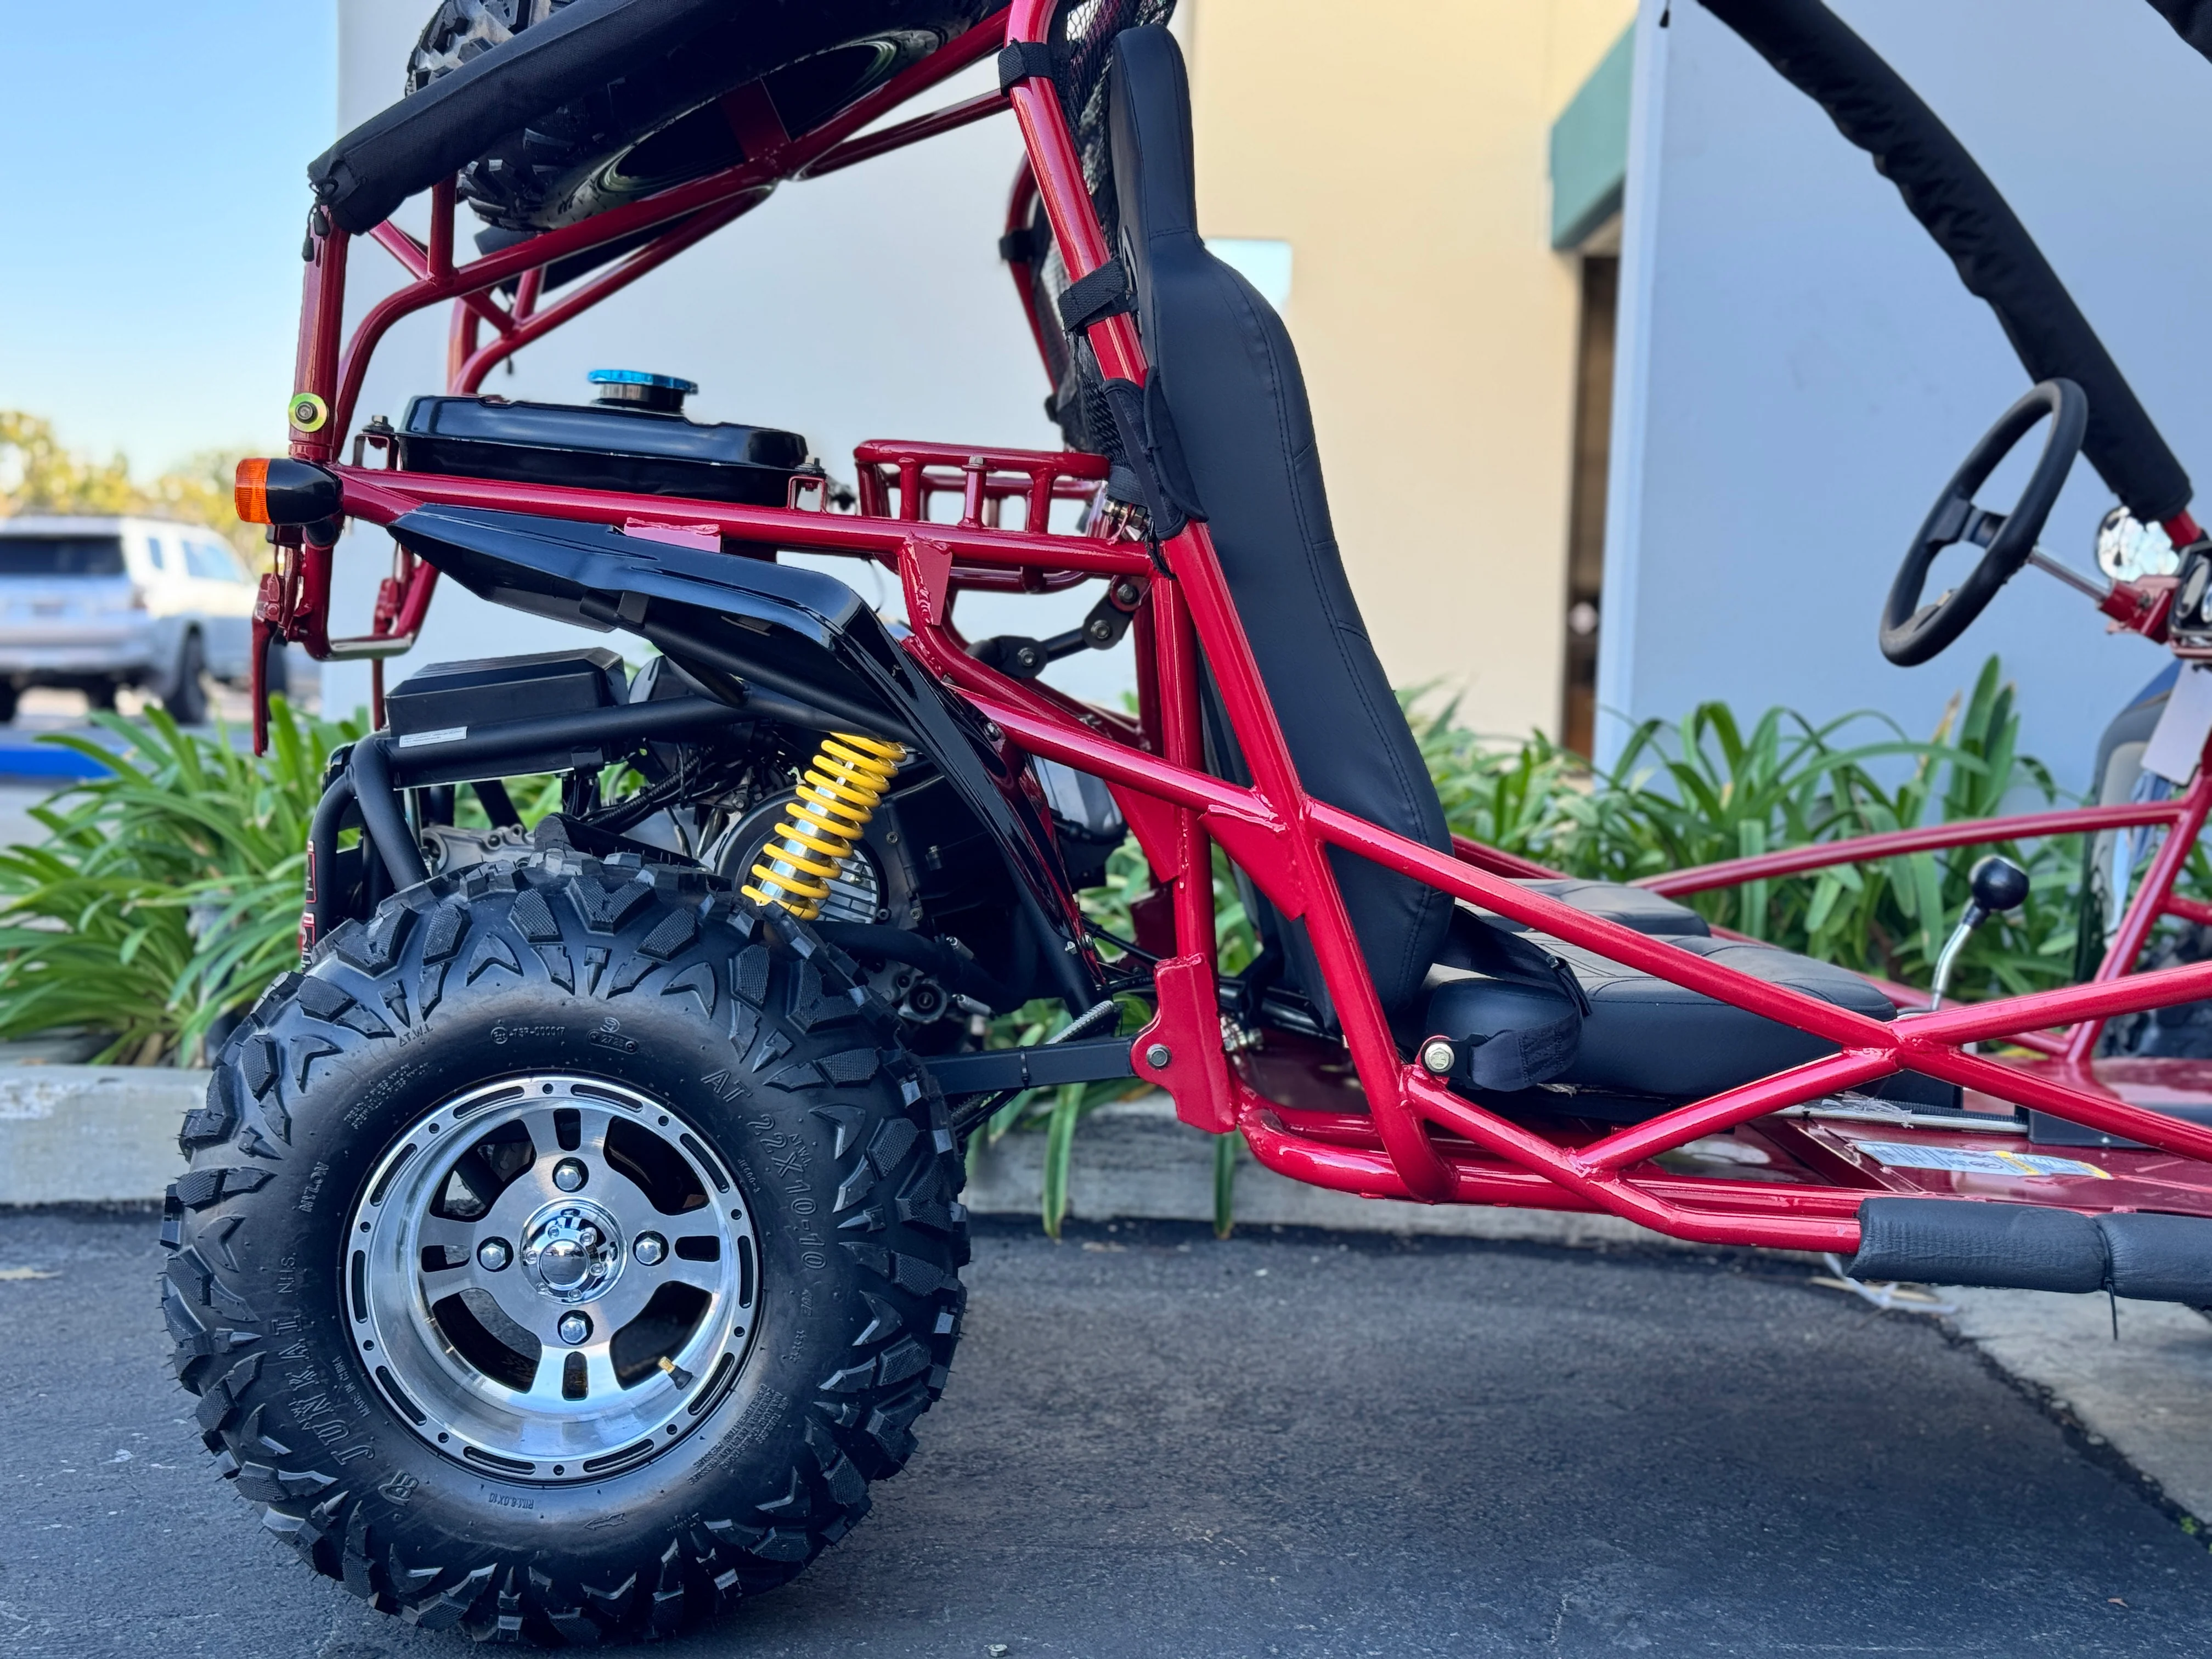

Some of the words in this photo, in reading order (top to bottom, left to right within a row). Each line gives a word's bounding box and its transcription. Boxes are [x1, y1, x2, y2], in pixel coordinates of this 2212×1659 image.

[701, 1069, 752, 1103] AT
[747, 1114, 826, 1269] 22X10-10
[298, 1161, 329, 1212] NYLON
[332, 1355, 348, 1382] CHINA
[273, 1314, 375, 1465] JUNKAI
[345, 1383, 356, 1393] IN
[351, 1395, 371, 1417] MADE
[720, 1426, 749, 1459] INFLATION
[757, 1412, 781, 1443] TUBELESS
[693, 1441, 725, 1470] PRESSURE
[687, 1457, 721, 1485] PRESSURE
